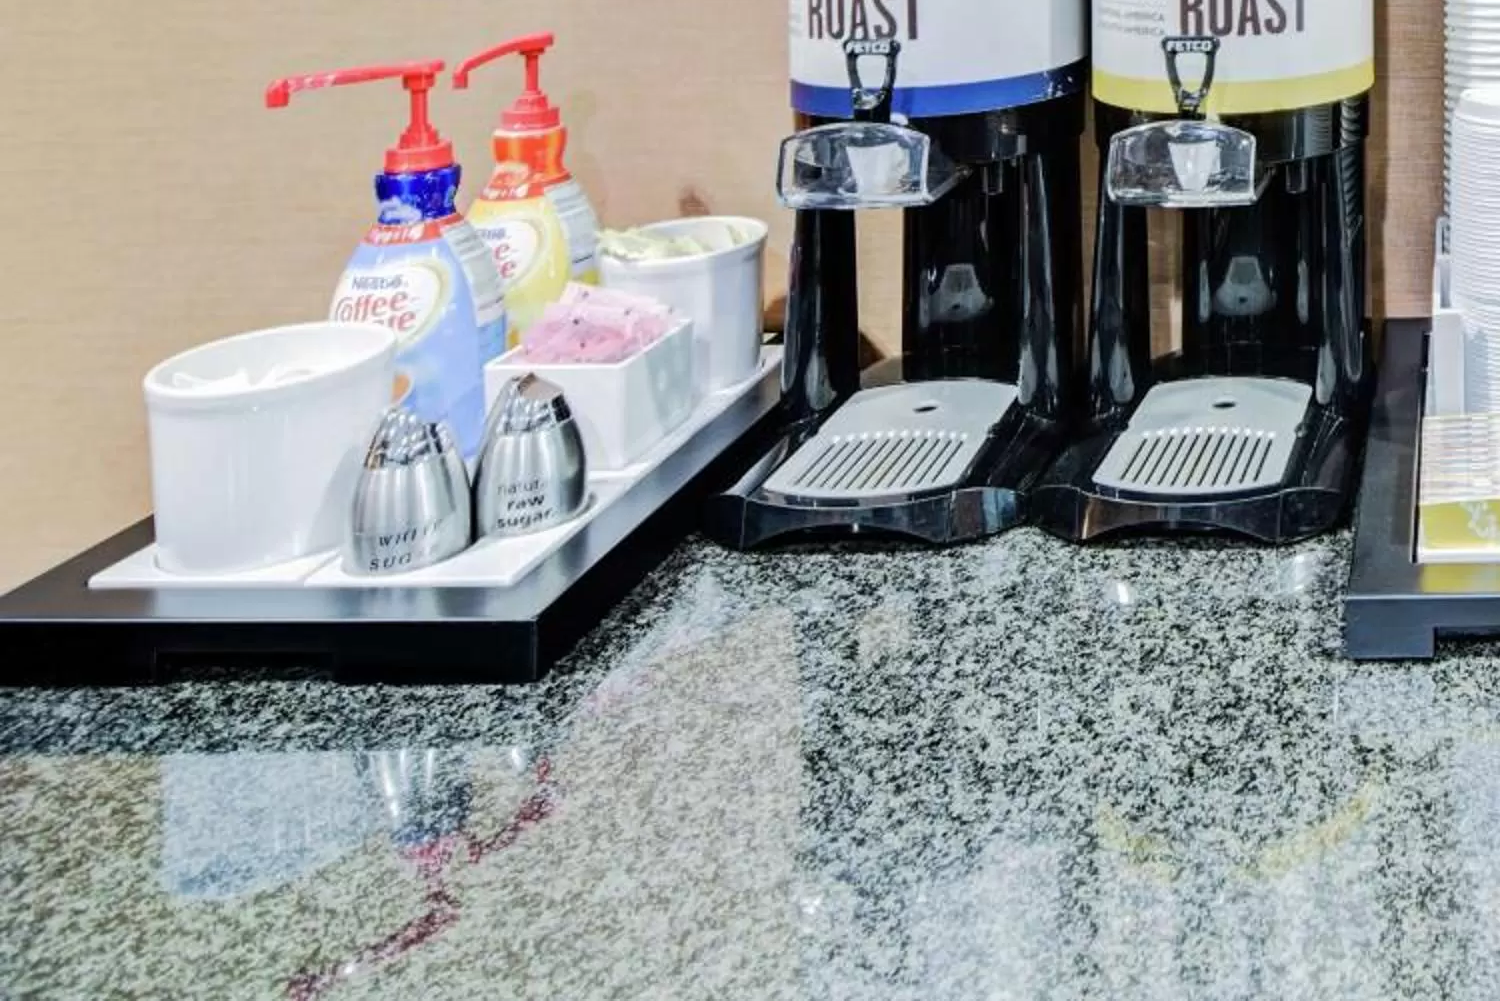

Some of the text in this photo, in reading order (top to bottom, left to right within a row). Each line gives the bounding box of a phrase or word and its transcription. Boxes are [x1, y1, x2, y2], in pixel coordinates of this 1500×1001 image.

[1166, 40, 1212, 52] FETCO
[507, 495, 546, 511] raw
[497, 508, 553, 529] sugar
